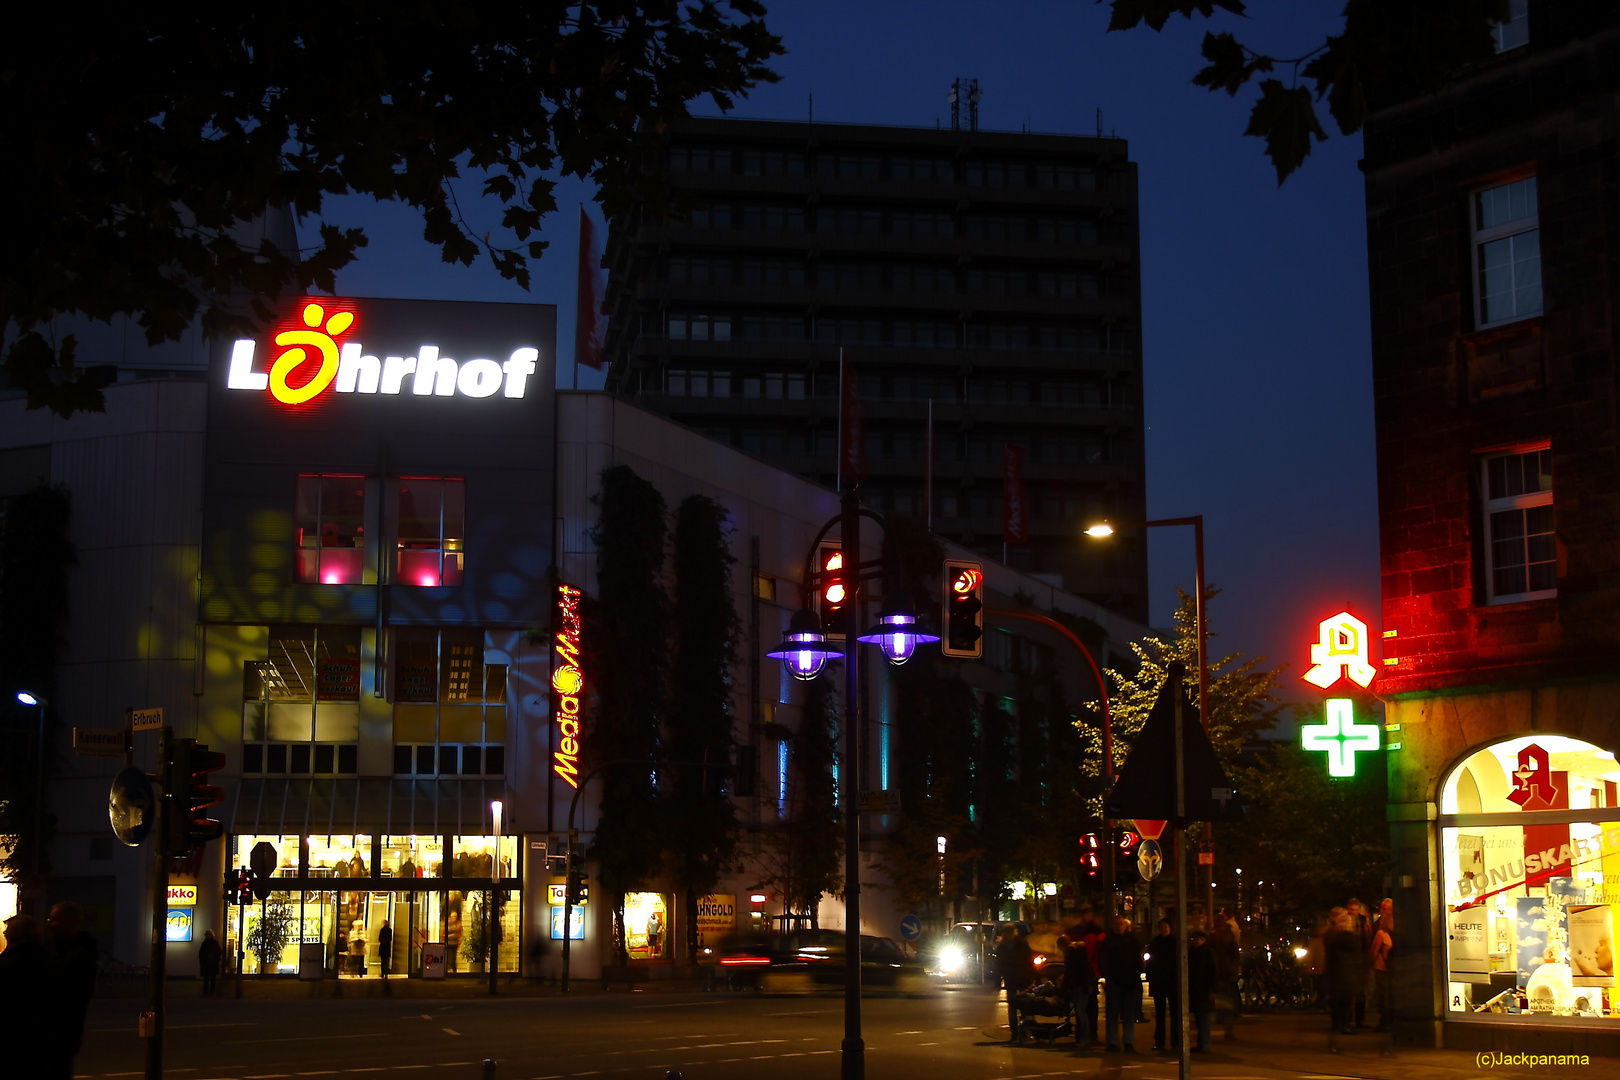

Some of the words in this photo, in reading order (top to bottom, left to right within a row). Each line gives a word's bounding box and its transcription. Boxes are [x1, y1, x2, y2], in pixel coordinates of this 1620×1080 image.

[227, 303, 540, 405] Löhrhof
[133, 711, 161, 726] Erlbruch
[78, 730, 123, 745] Kaiserwall
[1457, 827, 1620, 897] BONUSKARTE
[167, 888, 194, 898] akko
[698, 904, 733, 916] HNGOLD
[1454, 923, 1482, 931] HEUTE
